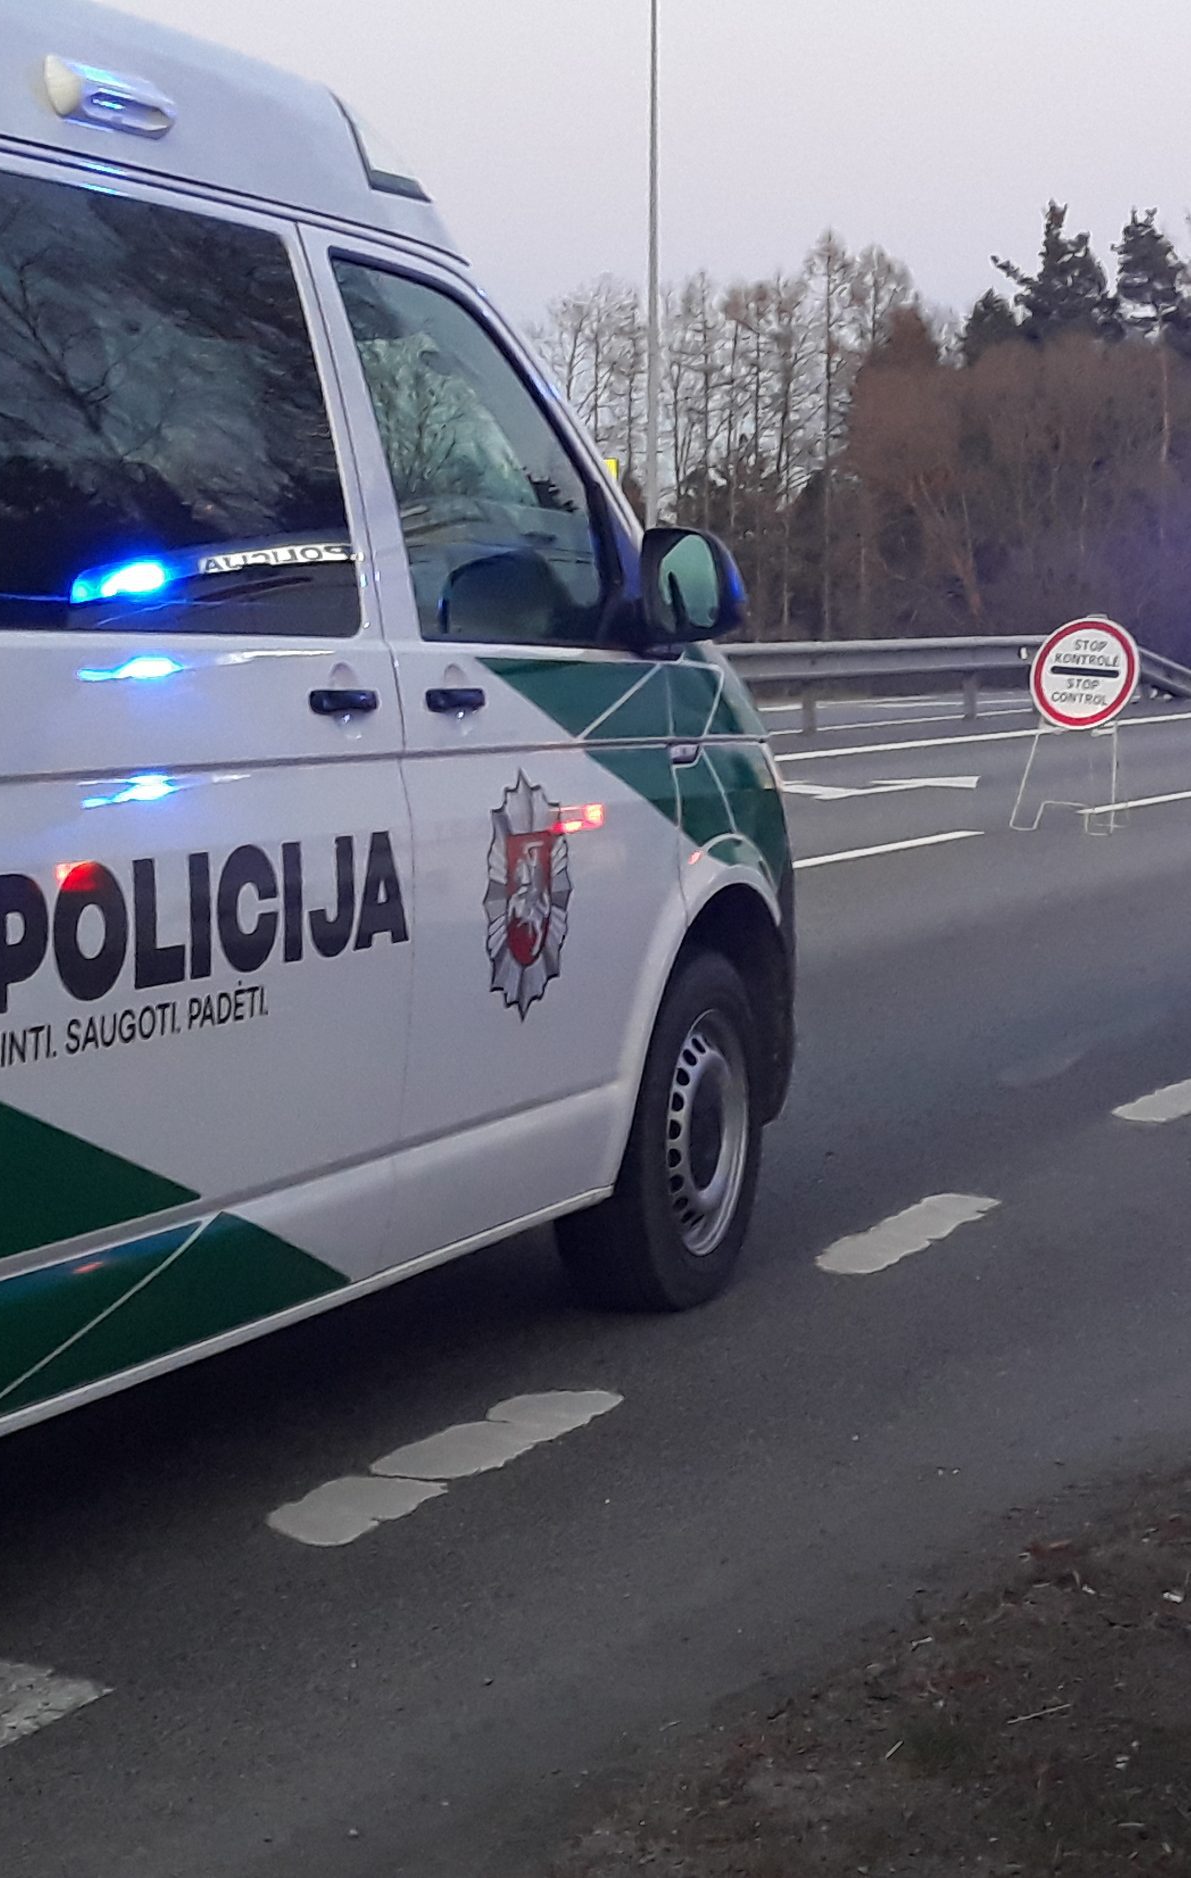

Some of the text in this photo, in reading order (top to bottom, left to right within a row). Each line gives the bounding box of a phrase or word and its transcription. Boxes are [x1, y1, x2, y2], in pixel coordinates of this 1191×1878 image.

[1074, 639, 1108, 653] STOP
[1067, 678, 1100, 690] STOP
[1051, 691, 1108, 706] CONTROL
[65, 1001, 182, 1054] SAUGOTI.
[188, 980, 269, 1030] PADĖTI.
